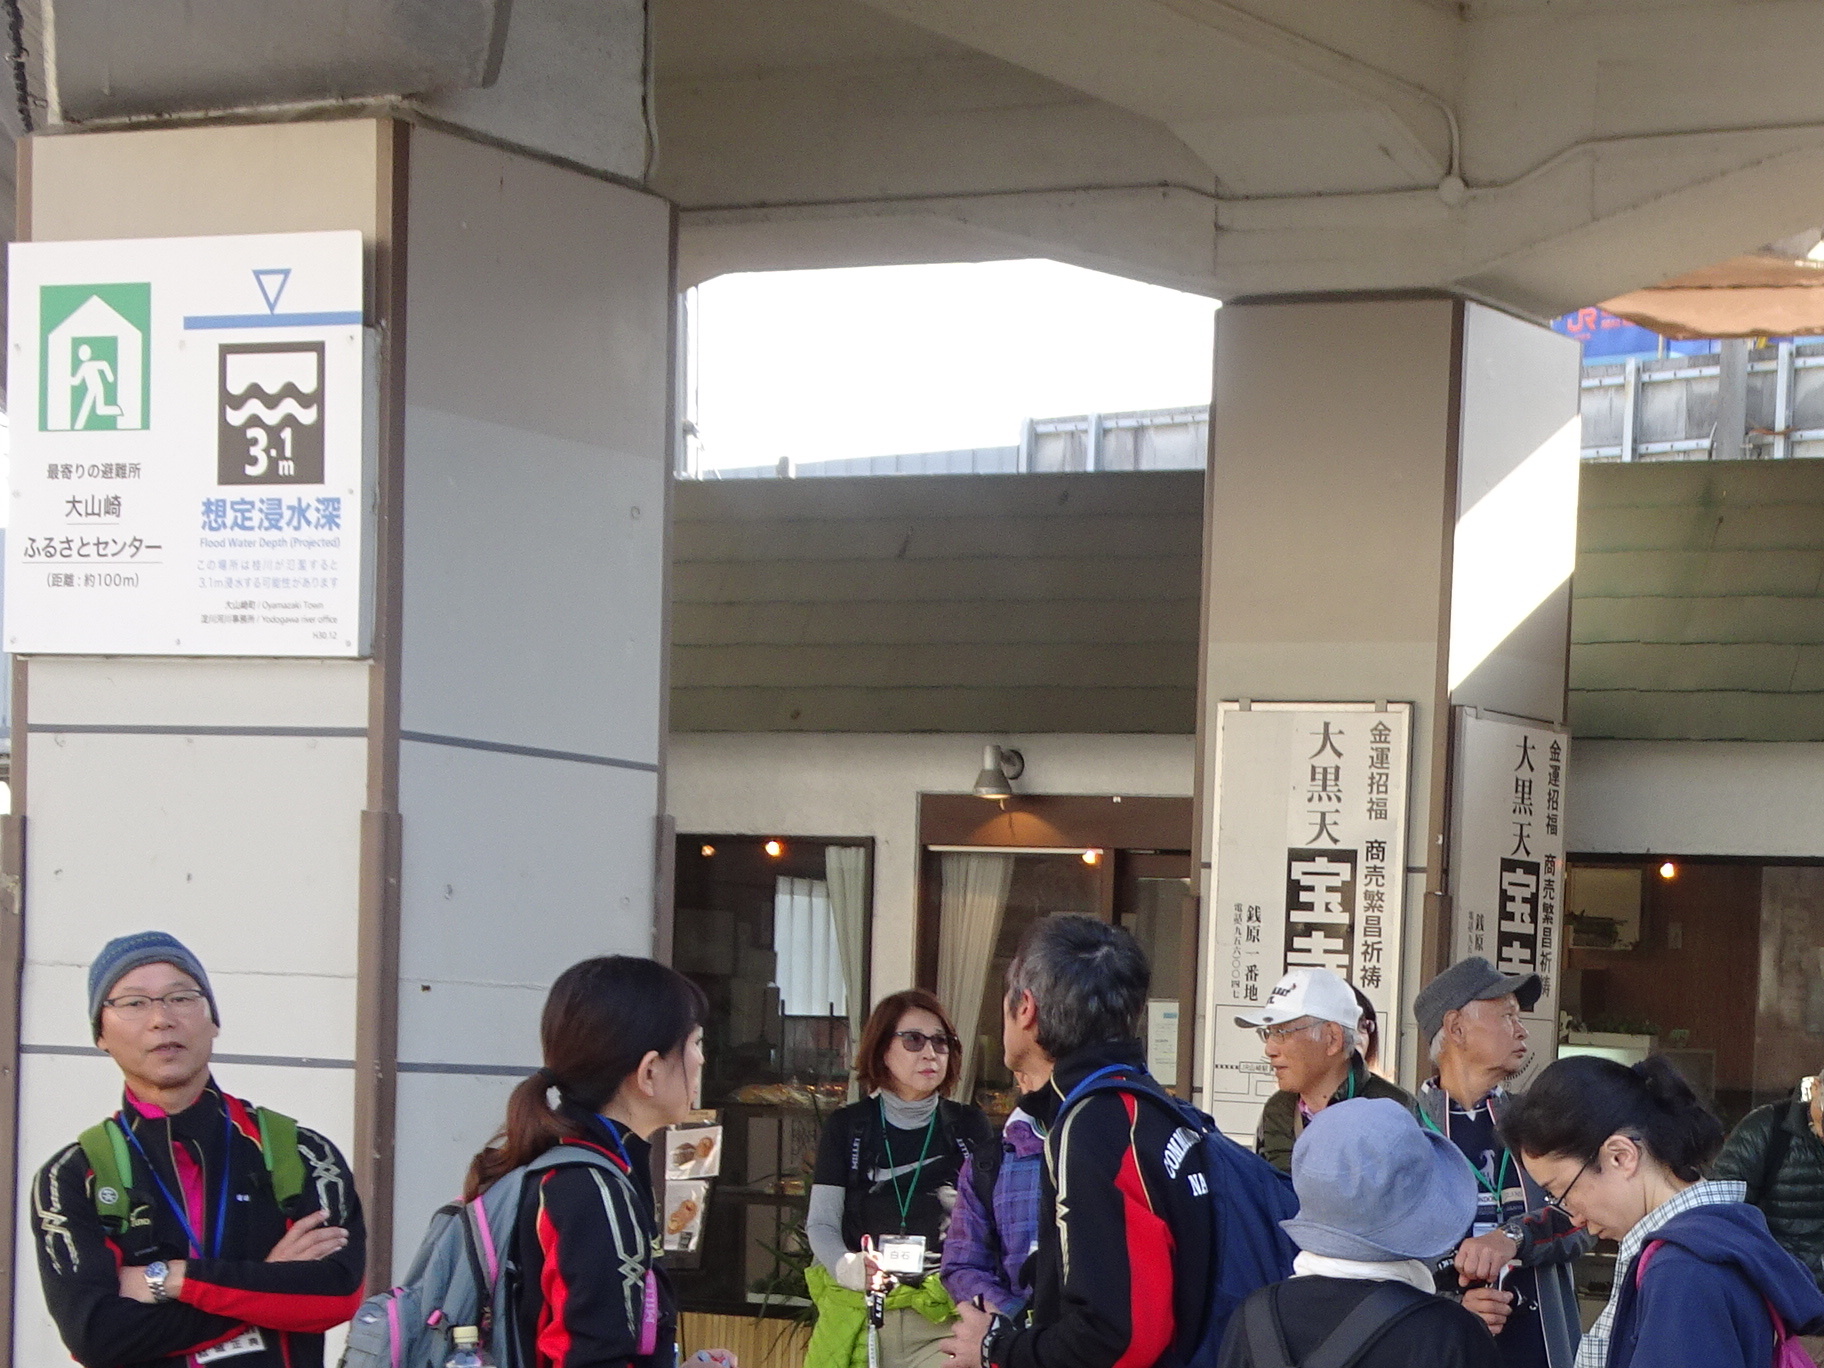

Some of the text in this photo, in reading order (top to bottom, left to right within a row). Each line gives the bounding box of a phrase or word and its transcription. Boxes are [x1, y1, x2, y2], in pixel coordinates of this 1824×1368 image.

[1567, 306, 1597, 333] JR
[46, 462, 142, 480] 最寄りの避難所
[65, 494, 122, 518] 大山崎
[201, 496, 341, 532] 想定浸水深
[23, 536, 163, 559] ふるさとセンター
[200, 537, 341, 549] Flood Water Depth (Projected)
[1305, 720, 1345, 846] 大黒天
[1366, 720, 1392, 821] 金運招福
[1510, 735, 1536, 858] 大黒天
[1545, 739, 1562, 837] 金運招福
